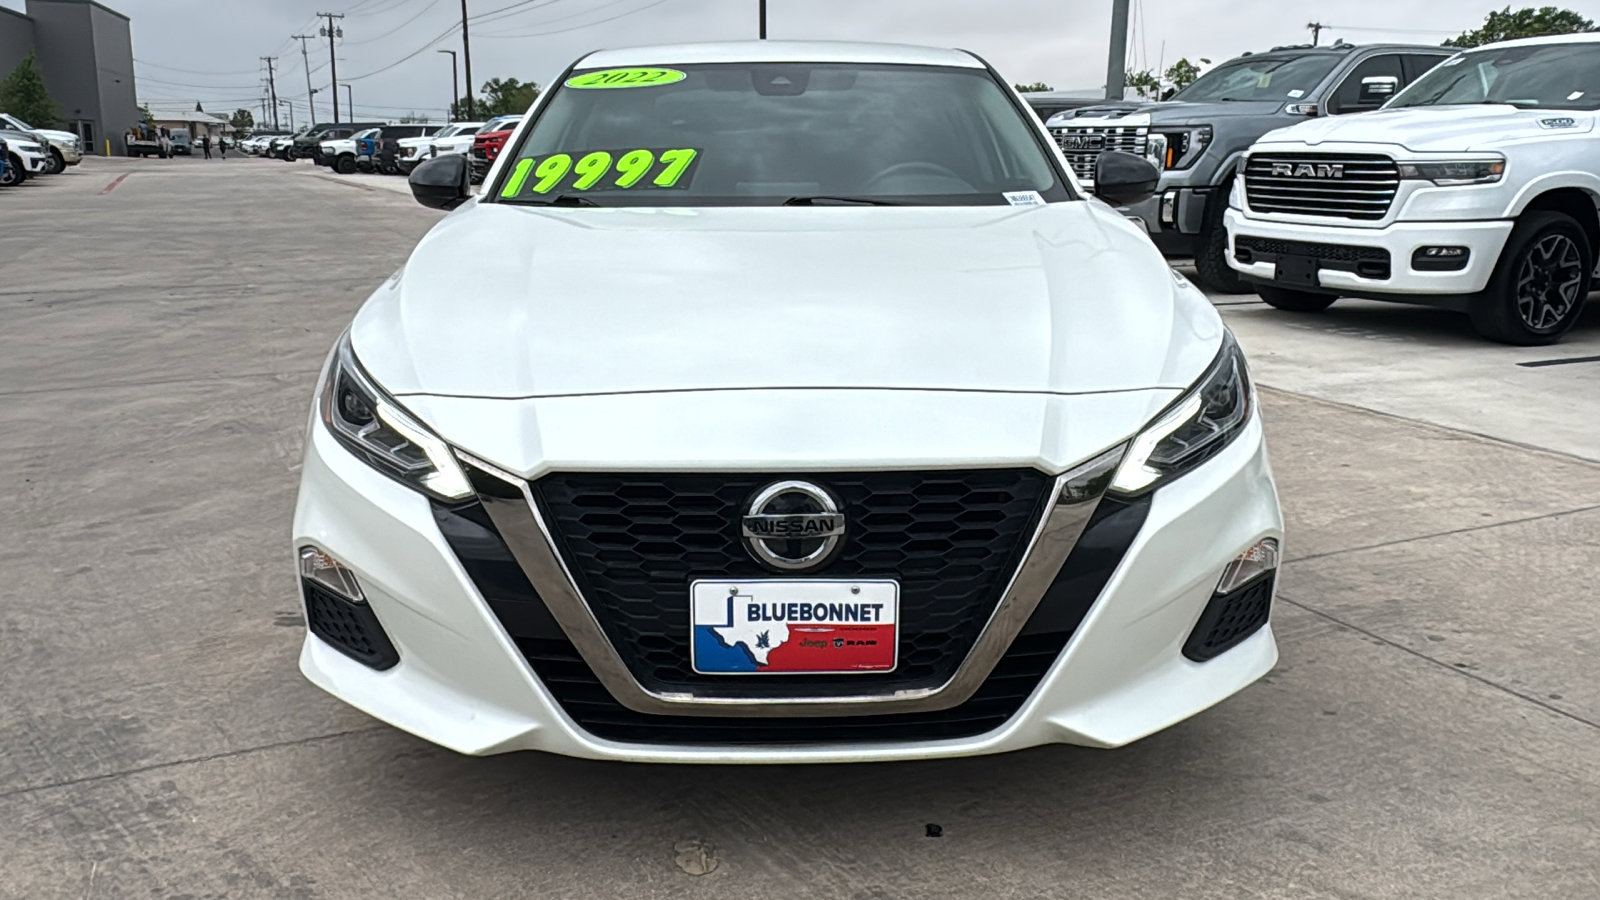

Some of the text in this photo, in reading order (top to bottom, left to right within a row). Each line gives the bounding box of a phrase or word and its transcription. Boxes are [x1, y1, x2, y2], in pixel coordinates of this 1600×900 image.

[583, 71, 667, 86] 2022
[1064, 136, 1102, 149] GMC
[501, 149, 697, 198] 19997
[1272, 163, 1344, 178] RAM
[754, 519, 834, 533] NISSAN
[748, 603, 883, 622] BLUEBONNET
[799, 638, 828, 648] Jeep
